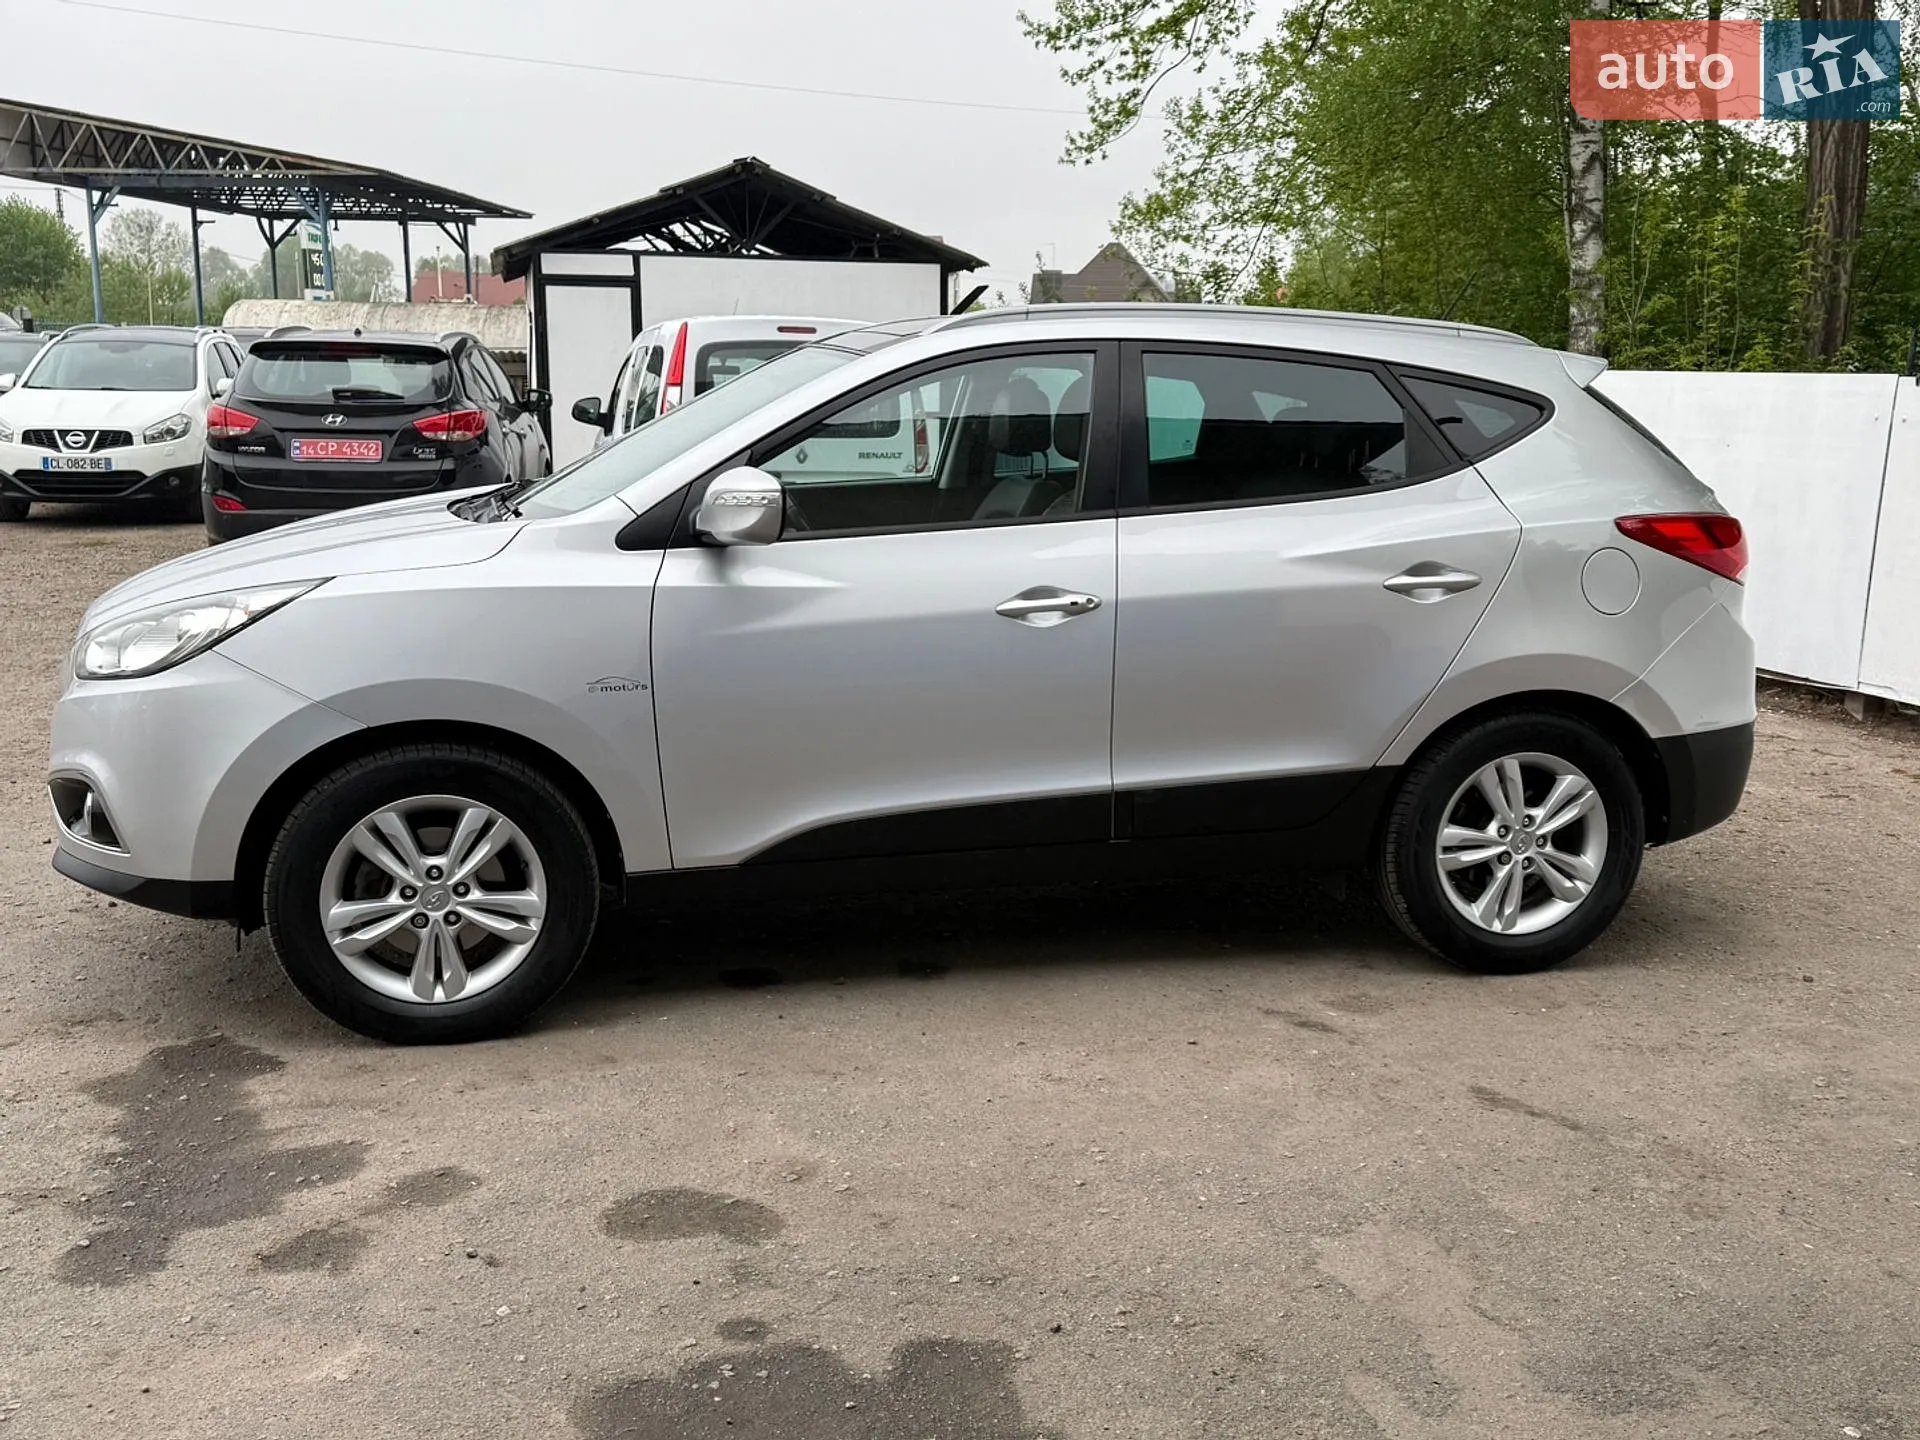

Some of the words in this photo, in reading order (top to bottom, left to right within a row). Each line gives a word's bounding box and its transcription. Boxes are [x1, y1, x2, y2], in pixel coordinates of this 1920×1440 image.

[301, 445, 315, 455] 14
[317, 442, 337, 455] CP
[342, 442, 376, 456] 4342
[858, 452, 903, 460] RENAULT
